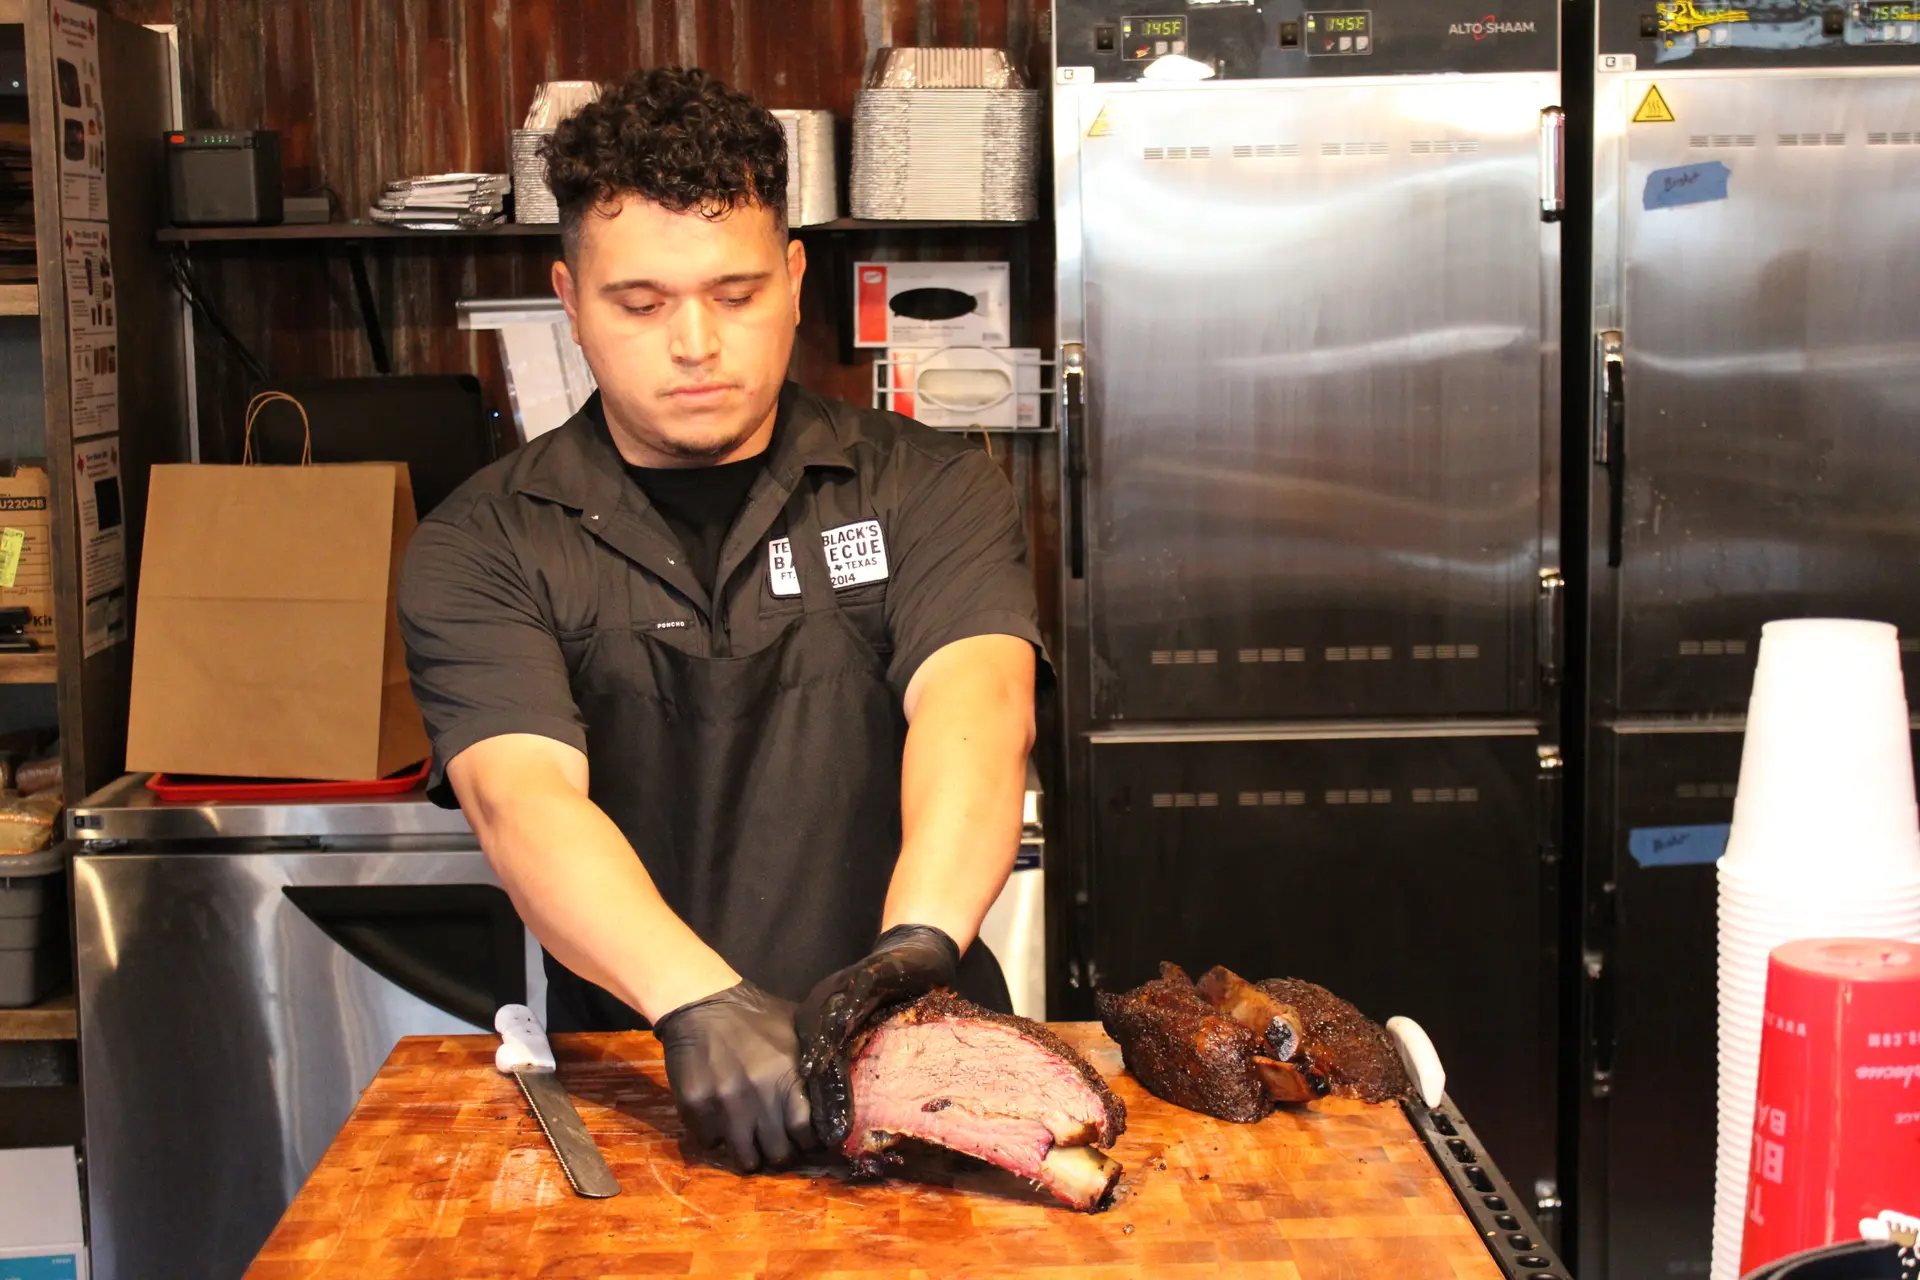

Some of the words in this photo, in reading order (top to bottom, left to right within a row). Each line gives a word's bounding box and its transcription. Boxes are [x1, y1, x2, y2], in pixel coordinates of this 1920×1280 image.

[1146, 21, 1181, 36] 145F
[1329, 16, 1365, 31] 145F
[822, 524, 879, 547] BLACK'S
[845, 557, 878, 570] TEXAS
[830, 573, 857, 587] 2014
[33, 613, 52, 627] Kit
[657, 621, 685, 629] PONCHO
